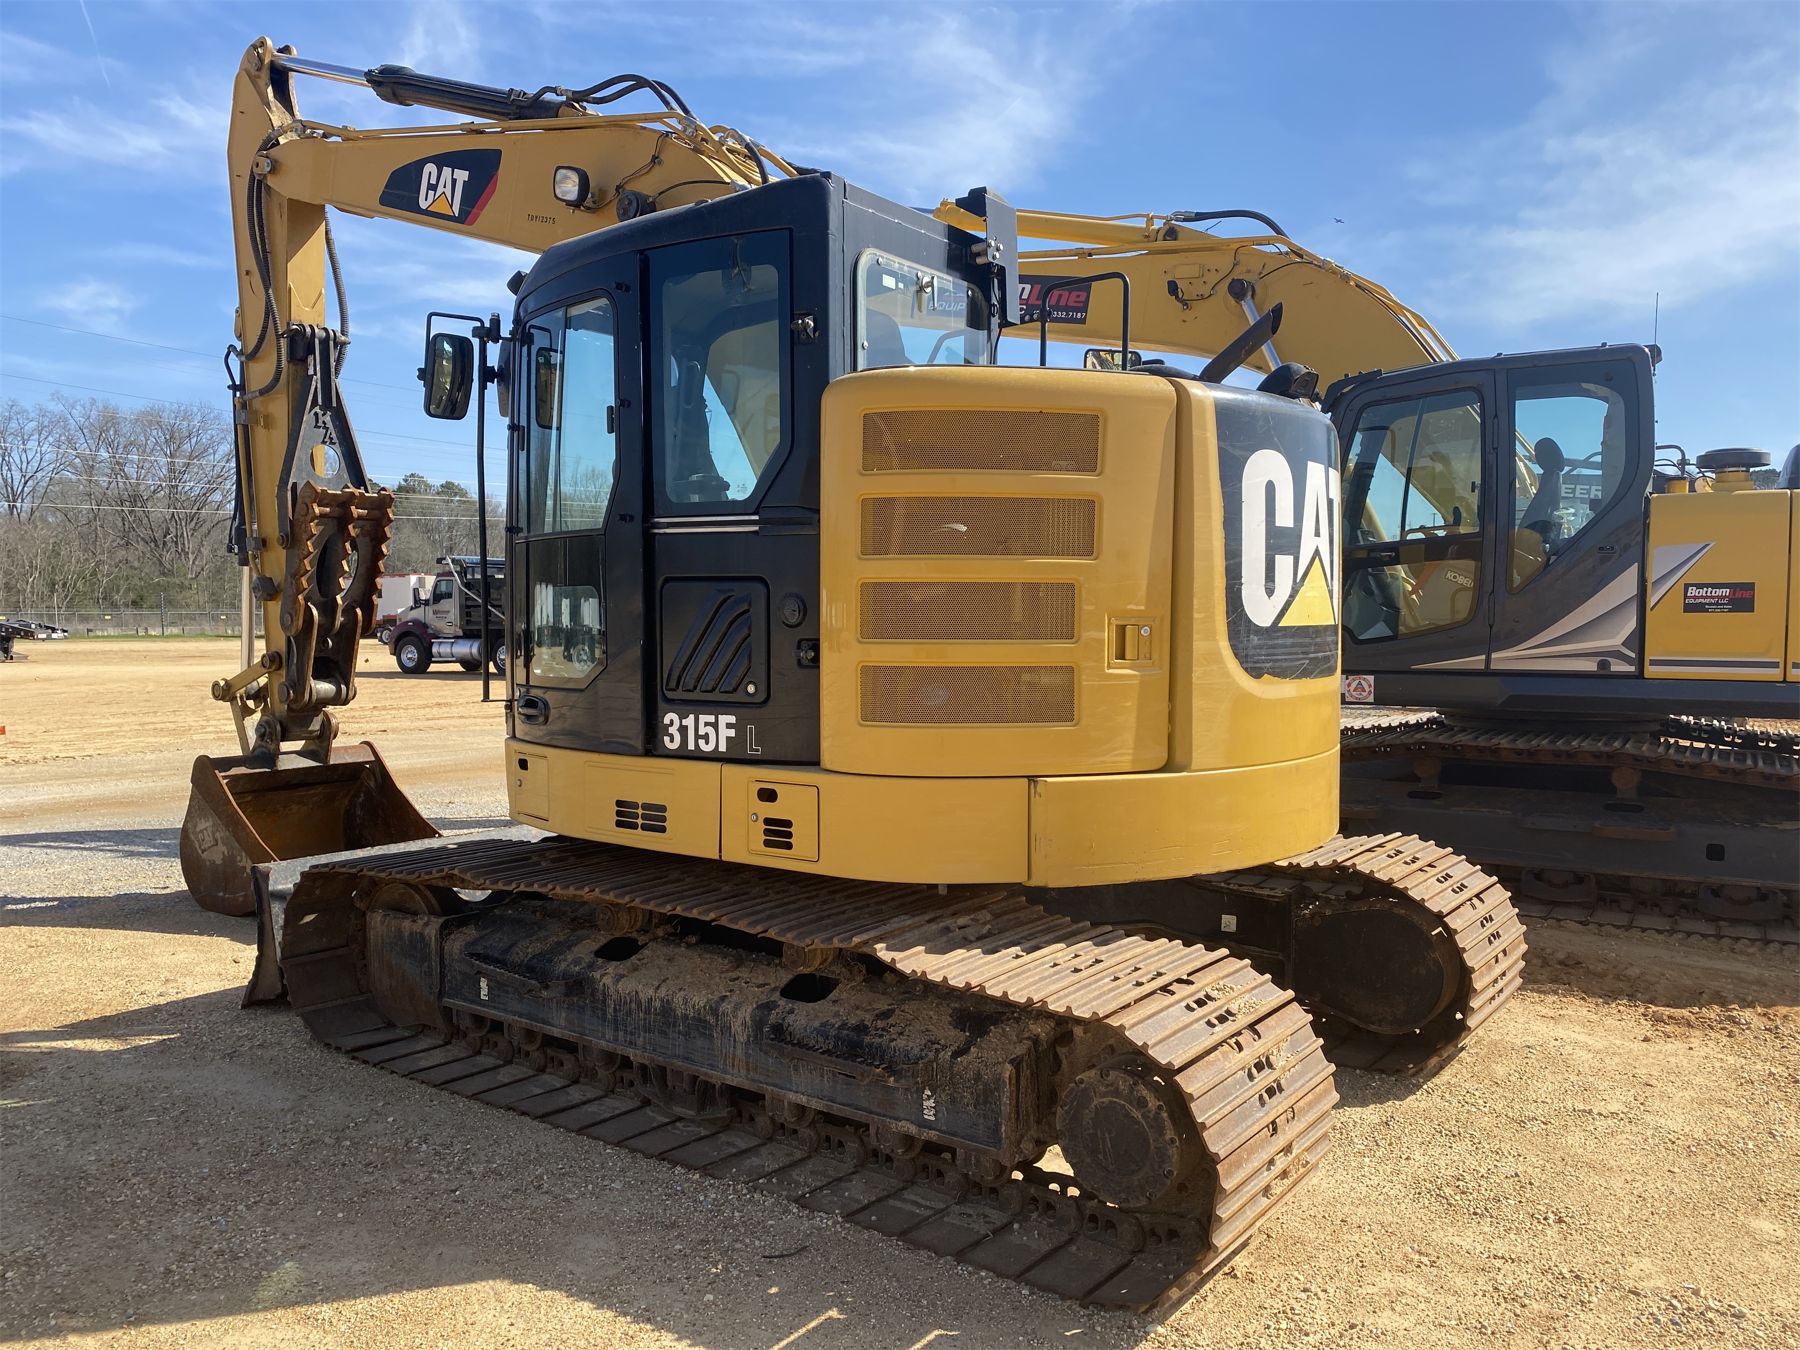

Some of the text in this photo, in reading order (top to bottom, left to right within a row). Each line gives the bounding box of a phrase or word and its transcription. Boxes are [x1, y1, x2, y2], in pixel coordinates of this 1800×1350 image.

[418, 162, 469, 217] CAT
[1052, 311, 1086, 319] 332.7187
[1242, 449, 1340, 627] CAT
[663, 712, 762, 754] 315F L
